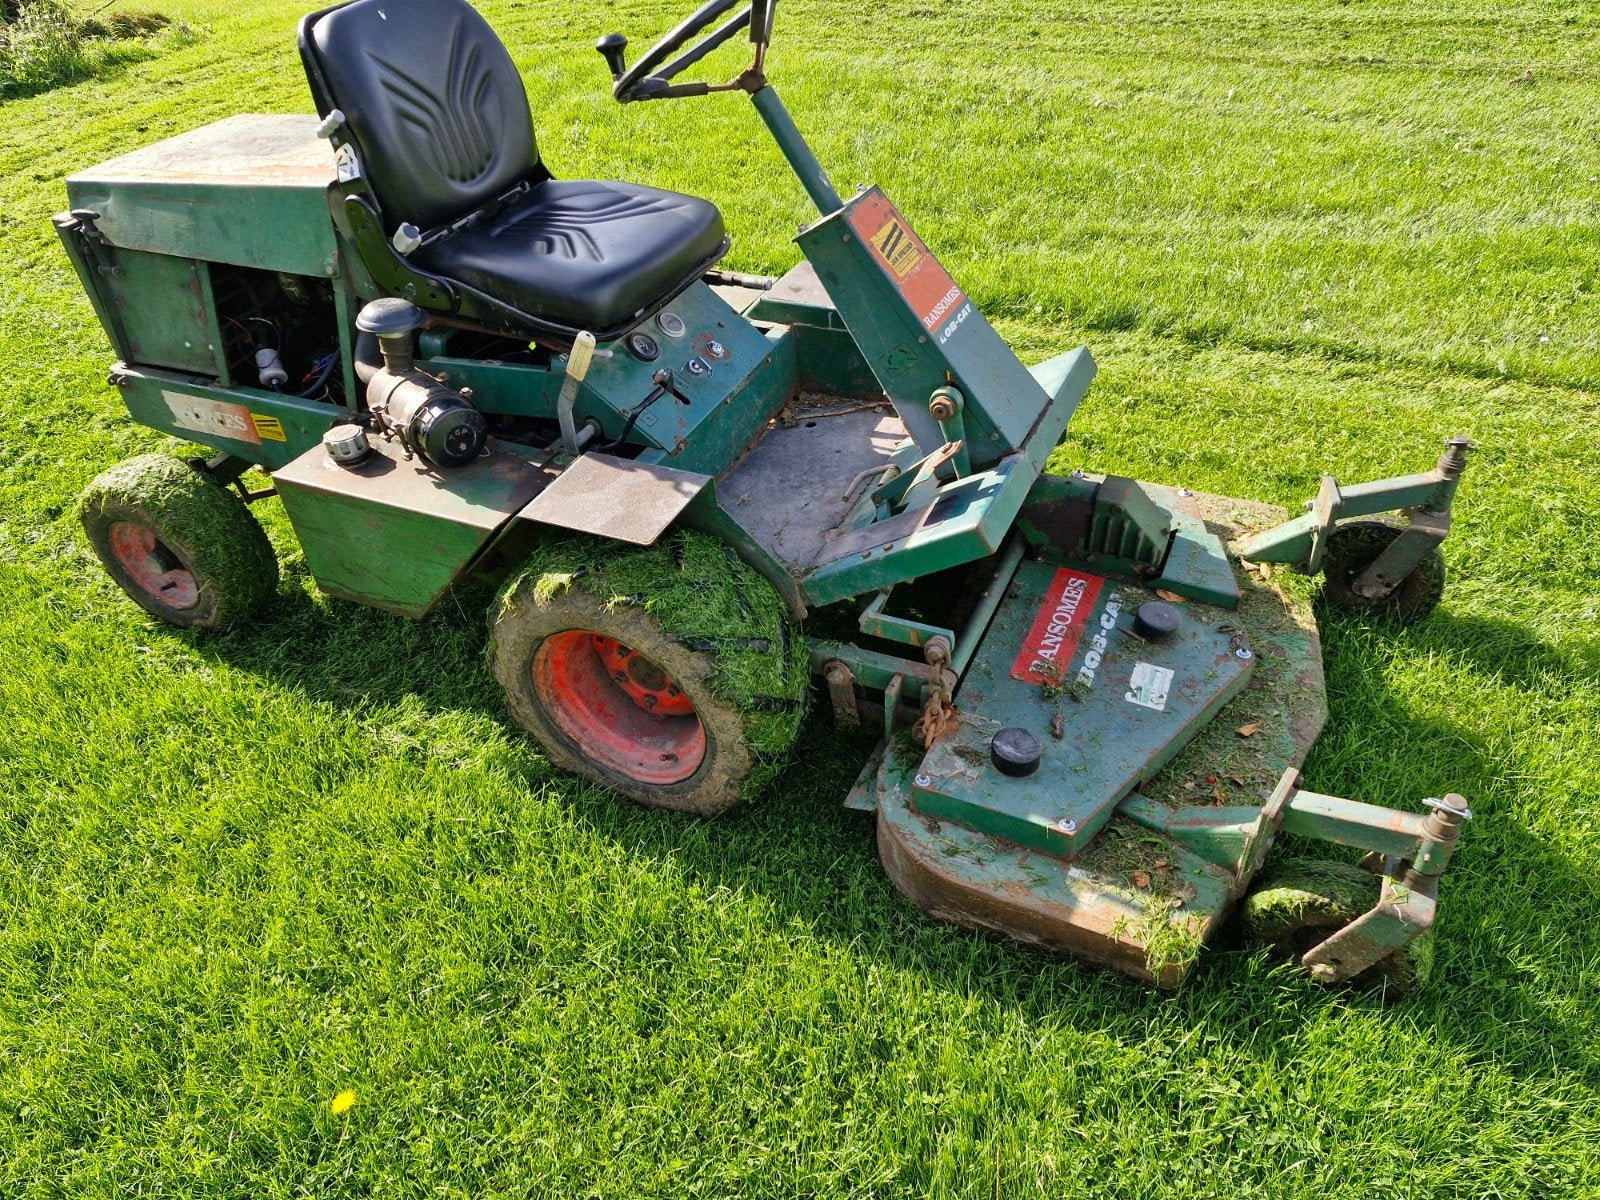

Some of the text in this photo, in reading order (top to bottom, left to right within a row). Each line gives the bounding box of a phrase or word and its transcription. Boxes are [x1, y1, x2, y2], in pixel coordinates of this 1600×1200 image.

[923, 285, 962, 328] RANSOMES
[449, 428, 468, 440] TOP
[1029, 577, 1089, 675] RANSOMES
